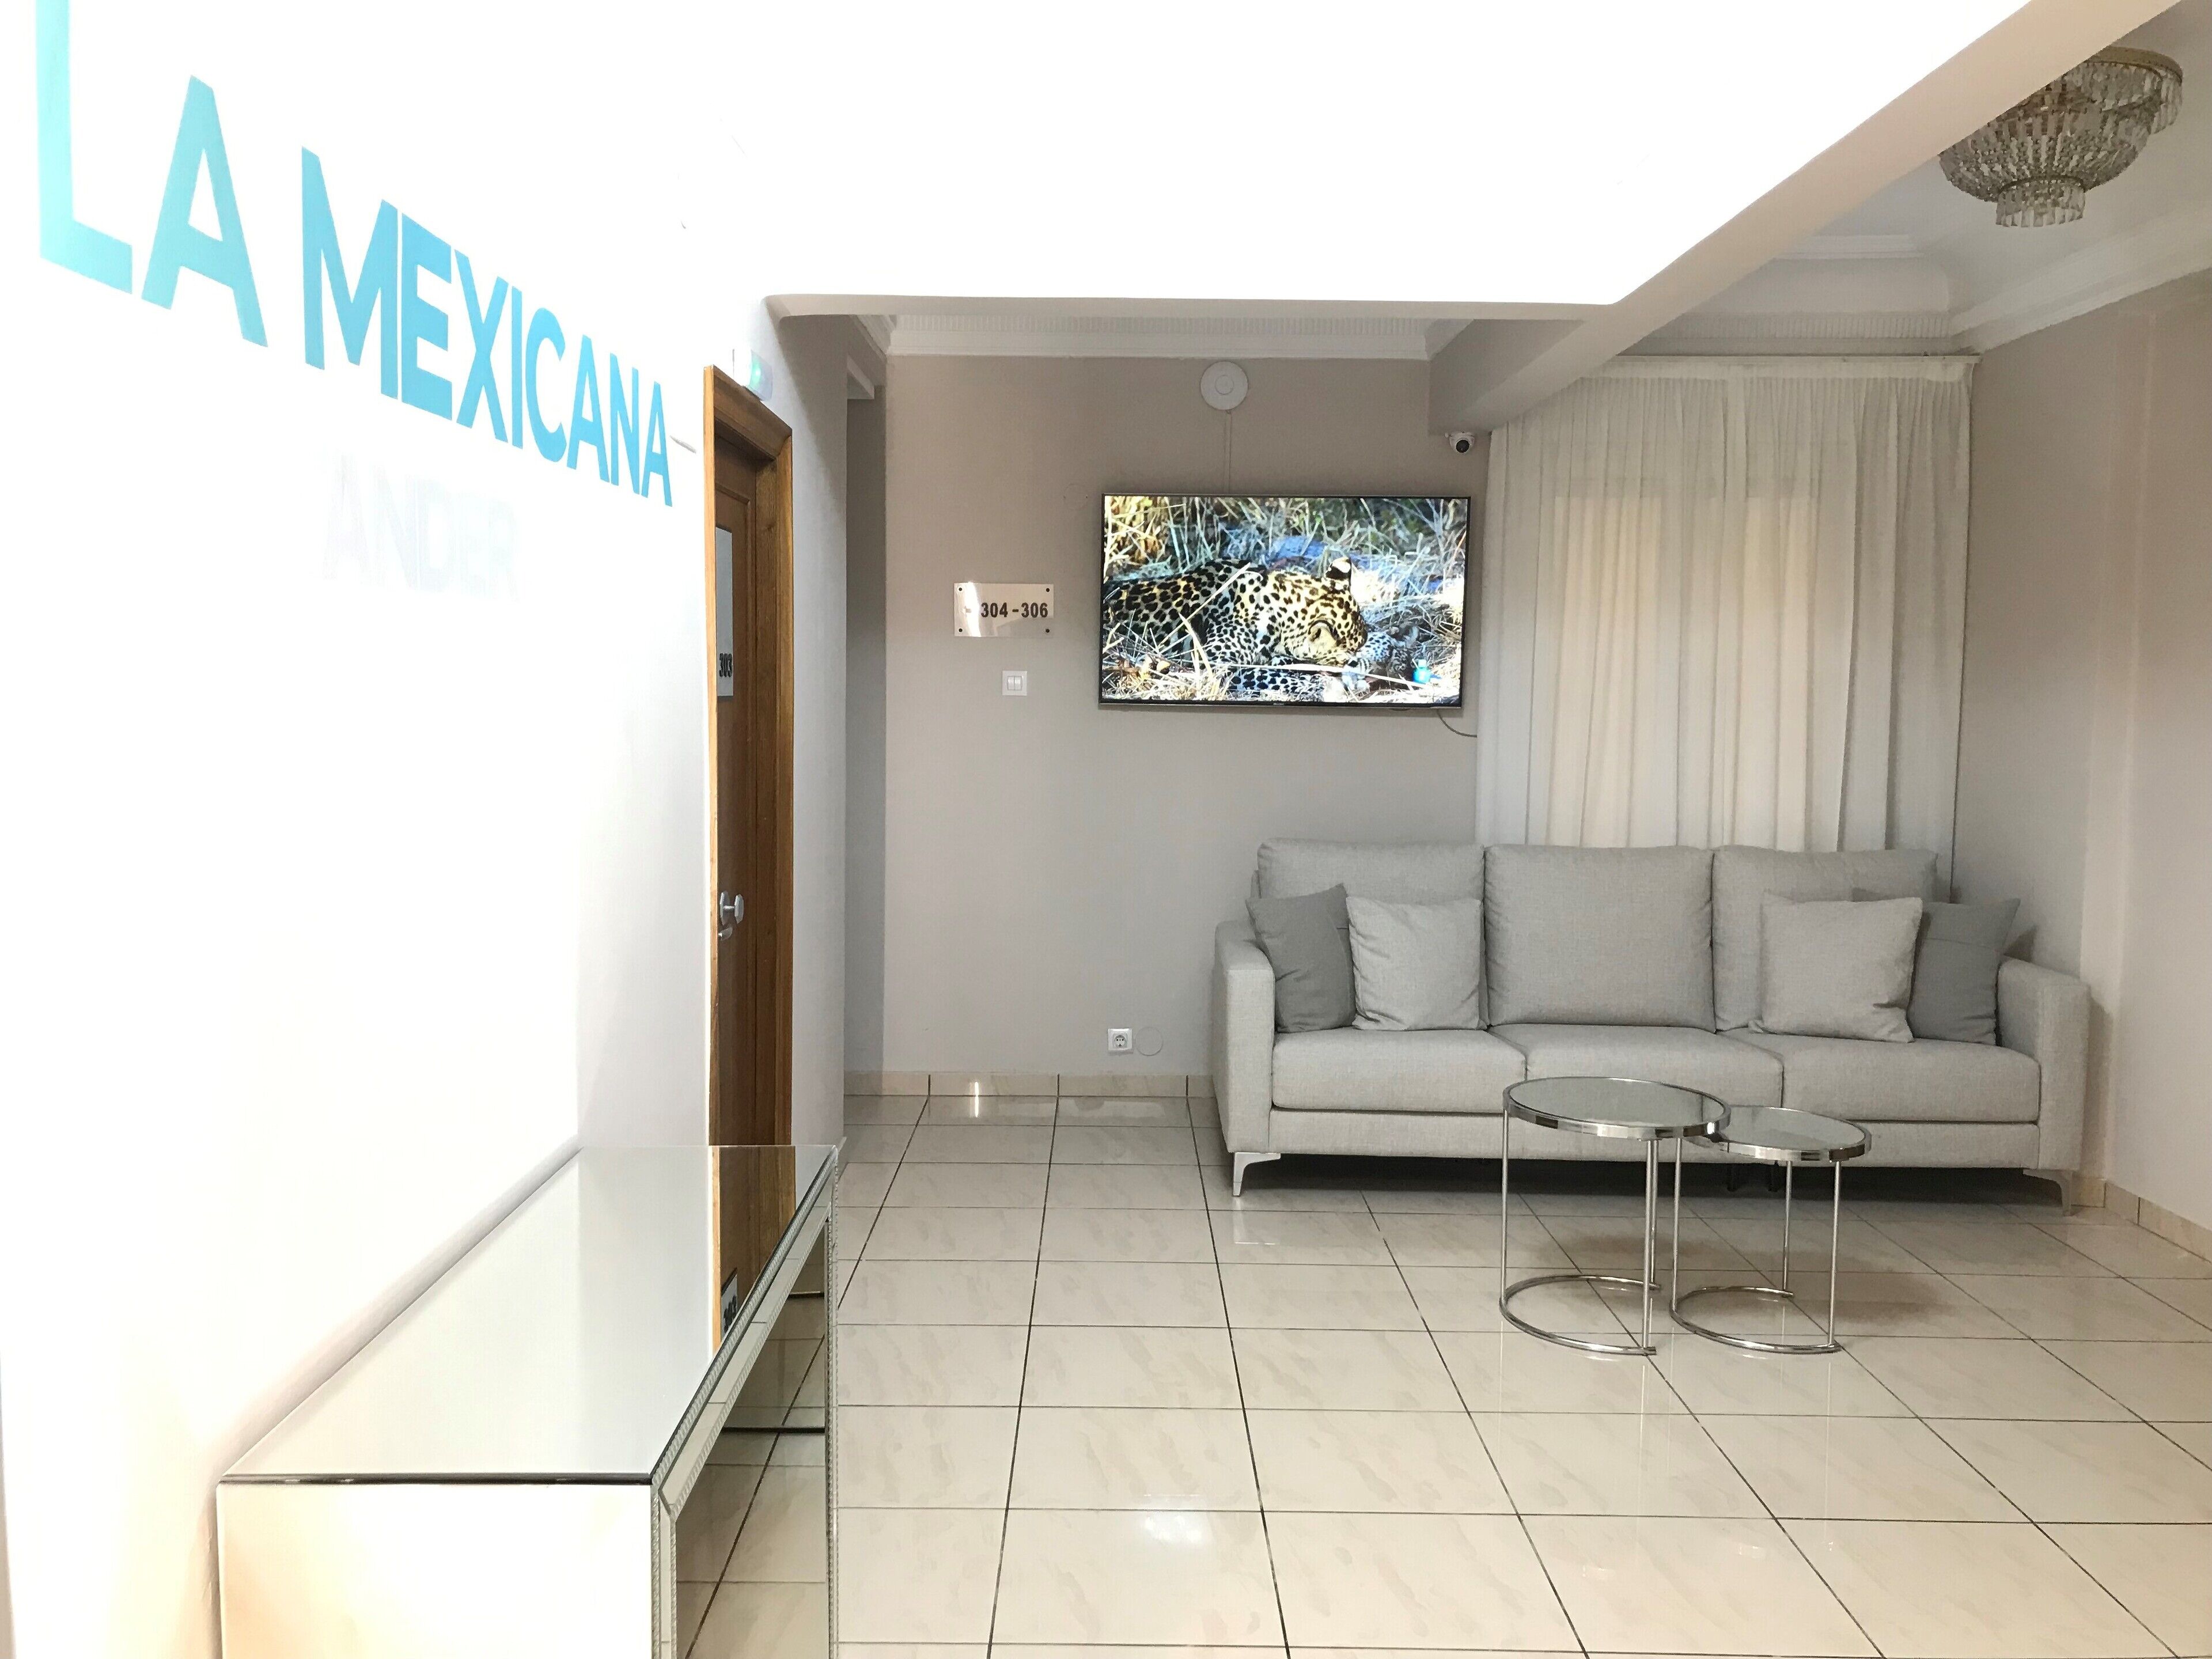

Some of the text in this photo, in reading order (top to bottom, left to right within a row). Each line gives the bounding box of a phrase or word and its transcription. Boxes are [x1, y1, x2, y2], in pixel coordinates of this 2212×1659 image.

[36, 0, 673, 507] LA MEXICANA
[719, 653, 732, 677] 303
